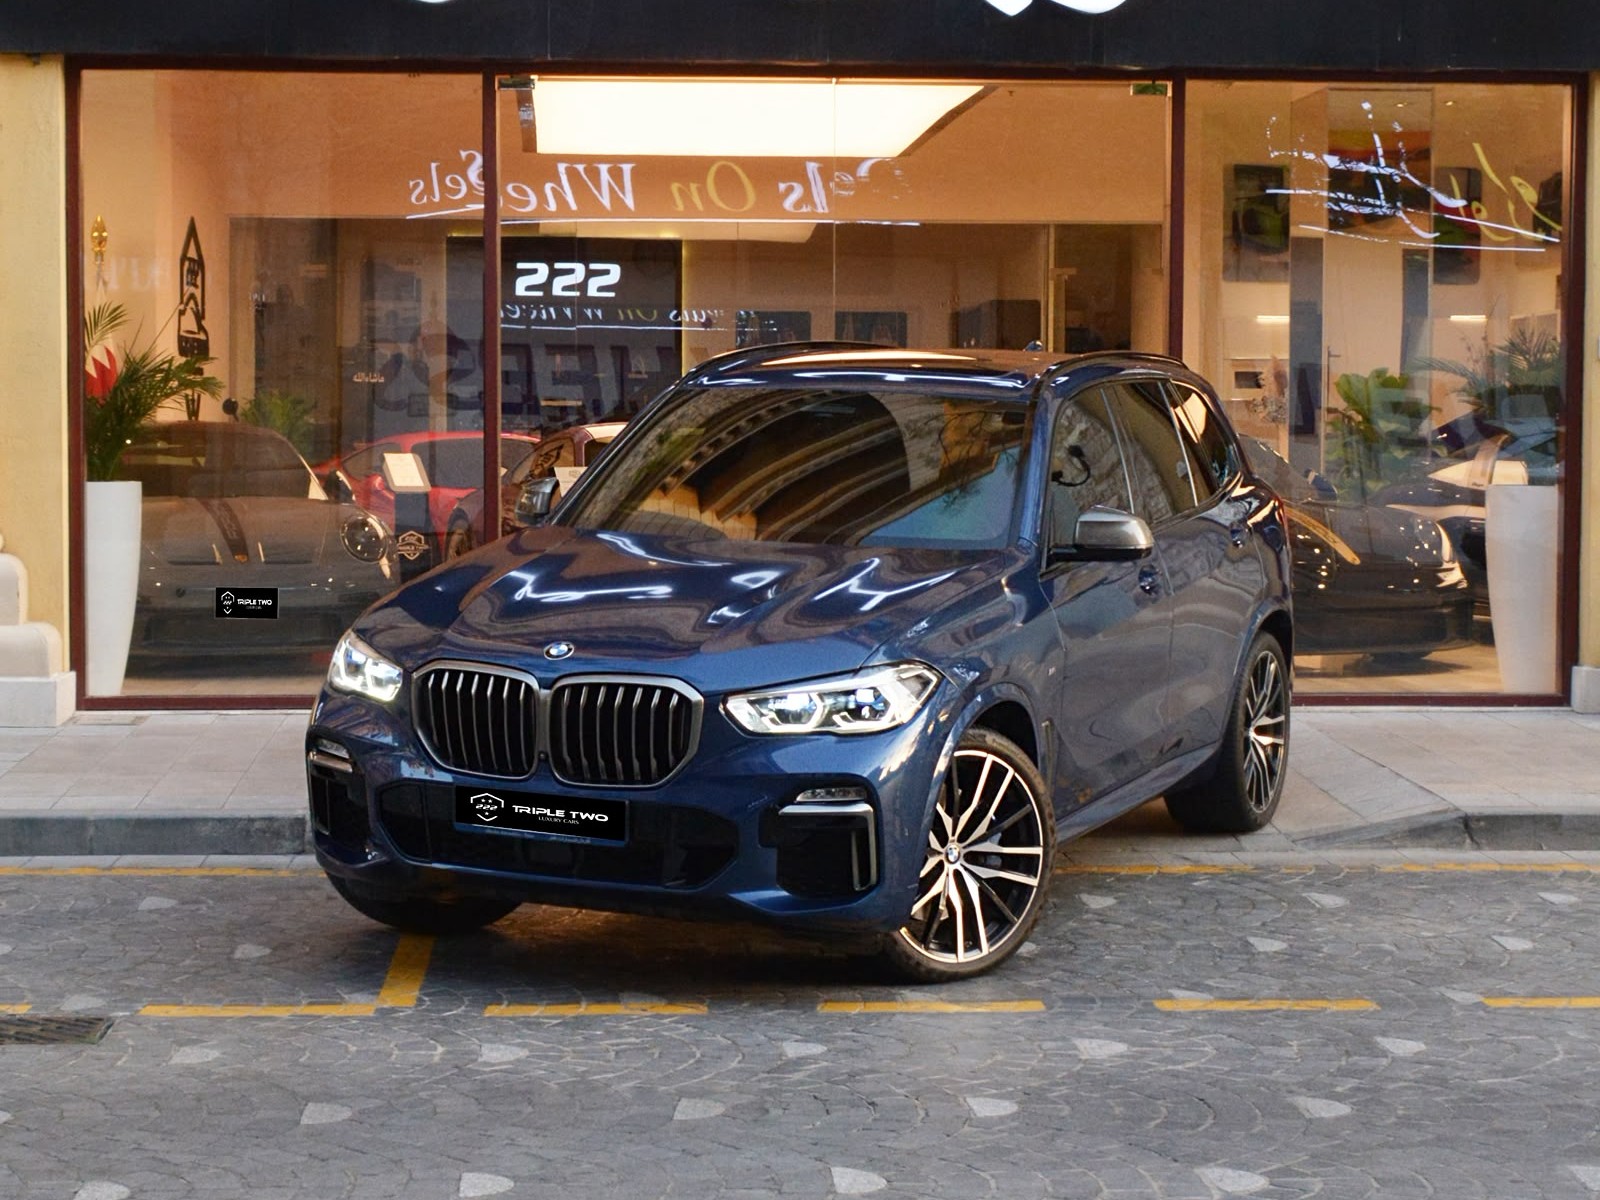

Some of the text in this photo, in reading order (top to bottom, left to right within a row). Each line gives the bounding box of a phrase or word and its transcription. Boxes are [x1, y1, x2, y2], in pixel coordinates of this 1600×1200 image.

[514, 262, 621, 297] 222
[512, 805, 609, 822] TRIPLE TWO
